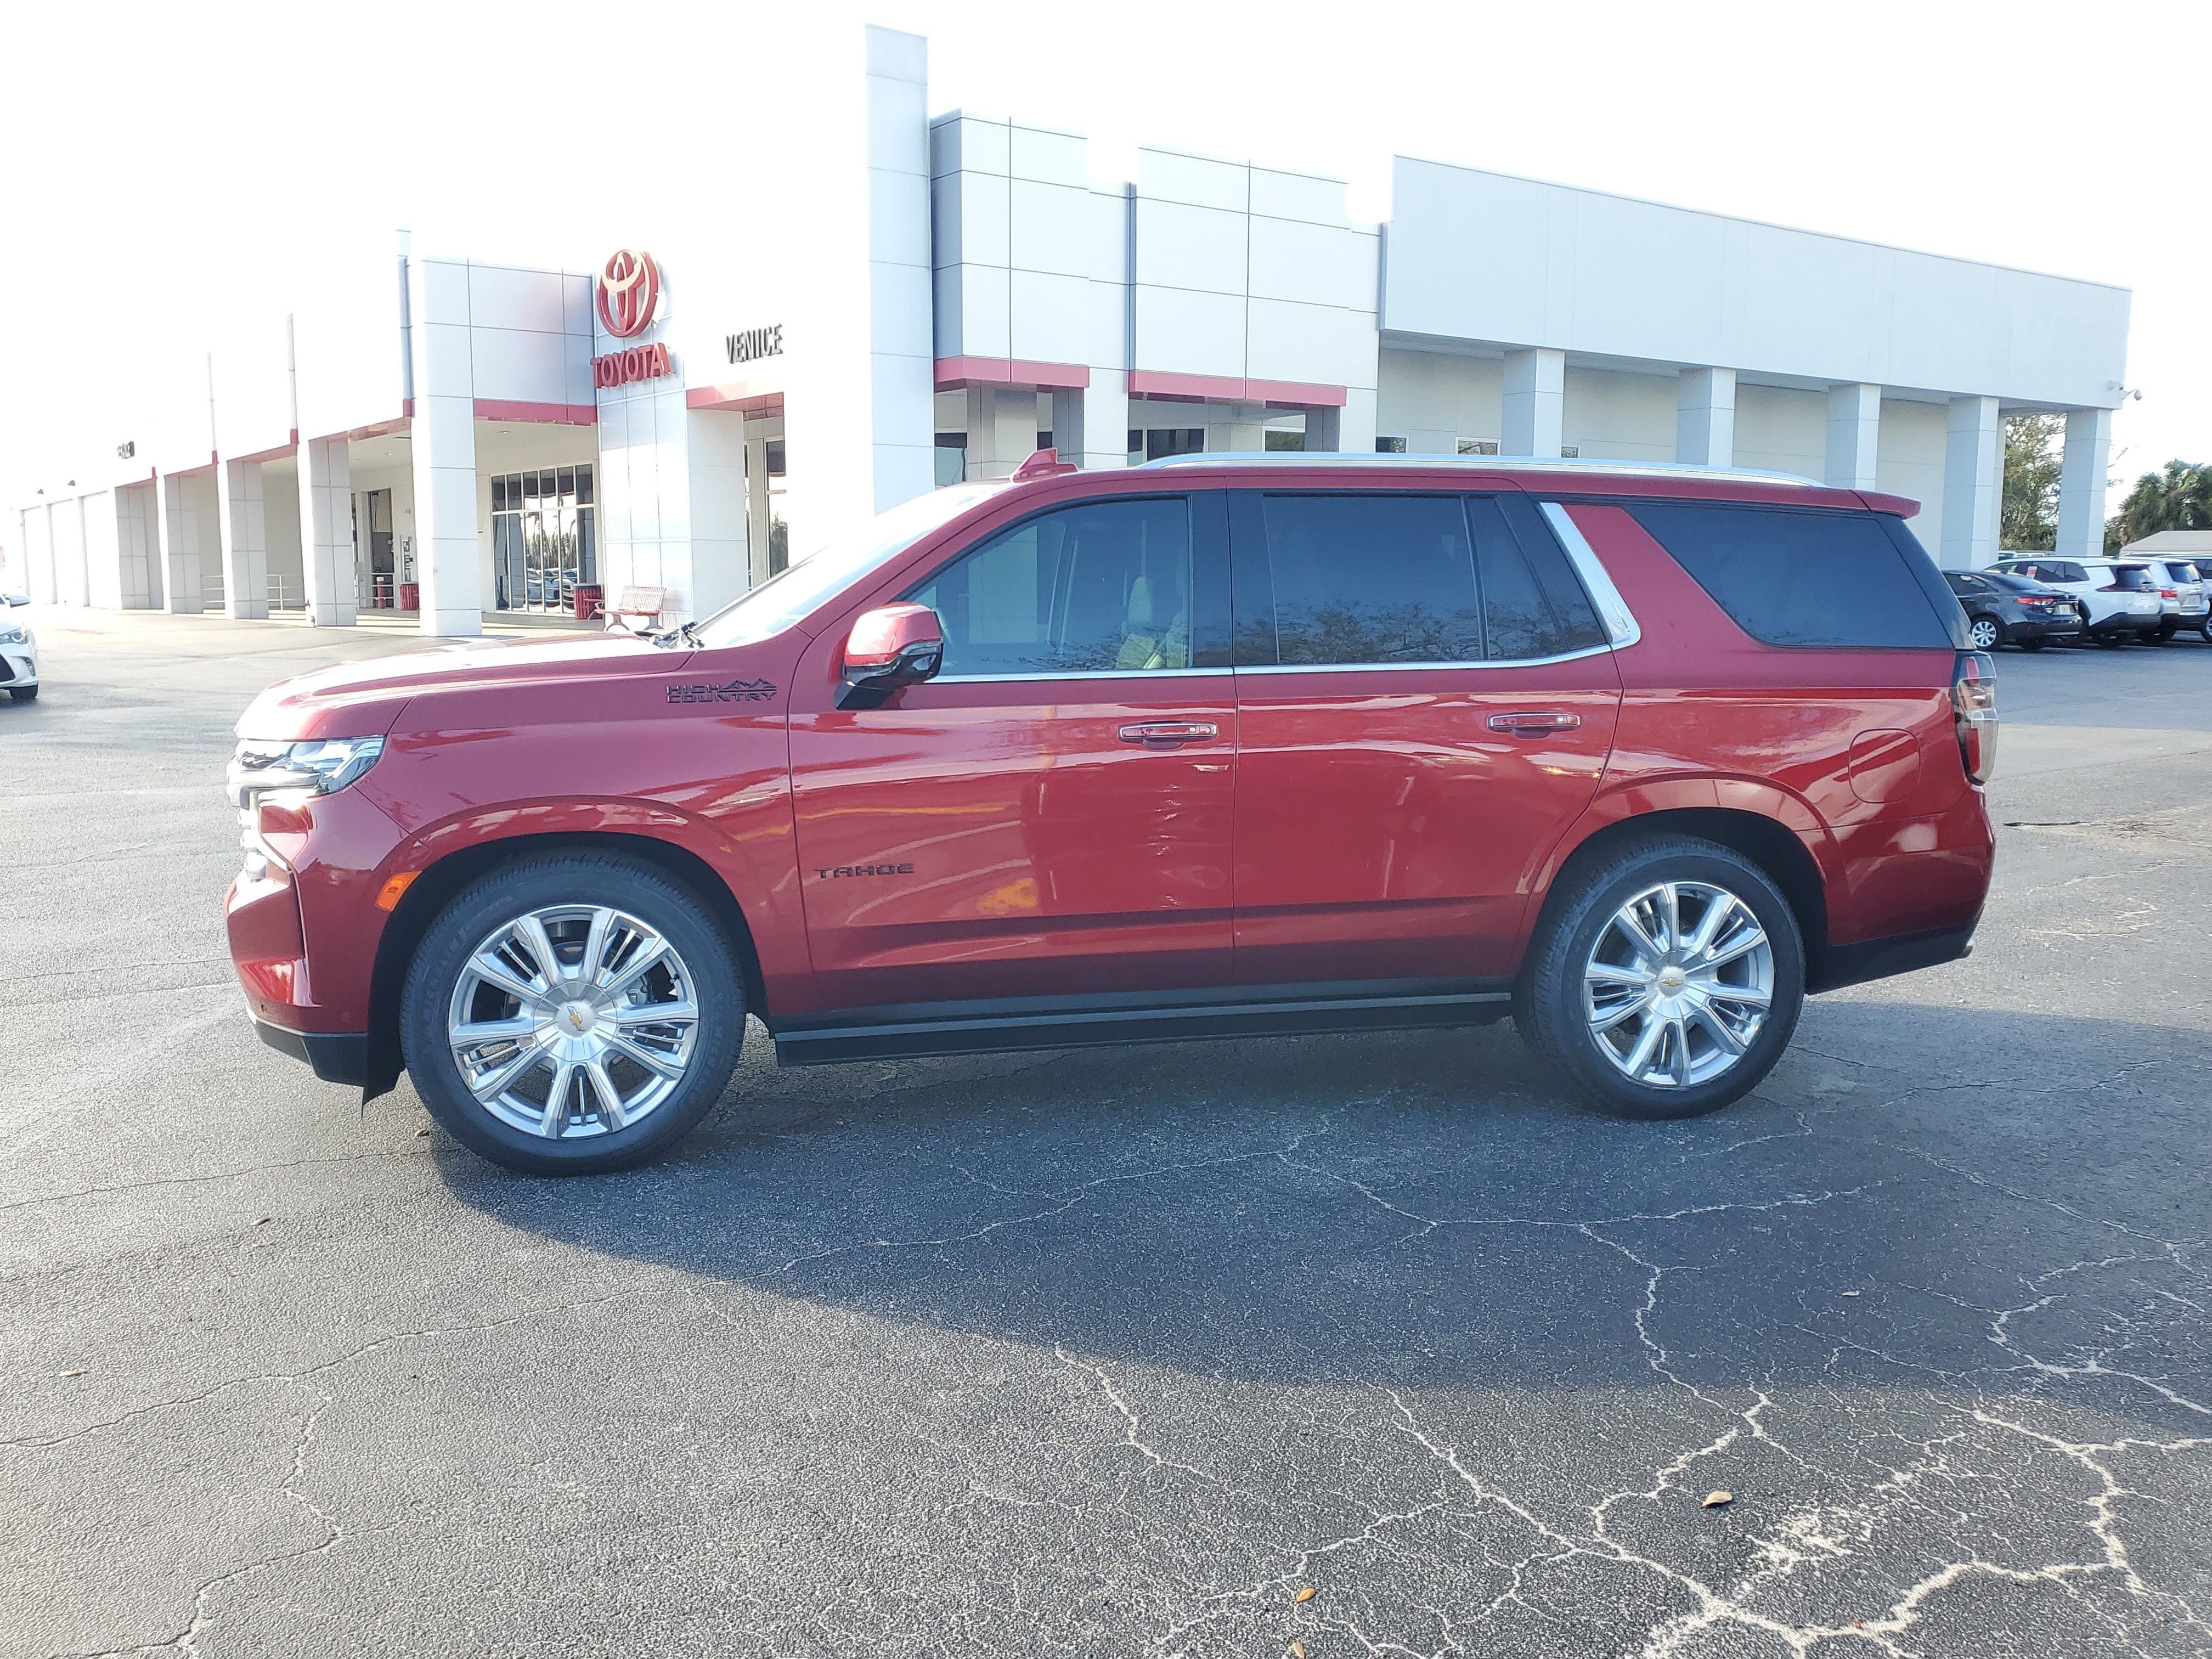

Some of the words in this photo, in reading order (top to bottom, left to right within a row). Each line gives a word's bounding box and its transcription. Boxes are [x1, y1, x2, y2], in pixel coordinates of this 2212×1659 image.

[726, 324, 783, 364] VENICE
[590, 342, 670, 388] TOYOTA
[666, 685, 720, 694] HIGH
[667, 692, 777, 703] COUNTRY
[814, 863, 915, 879] TAHOE
